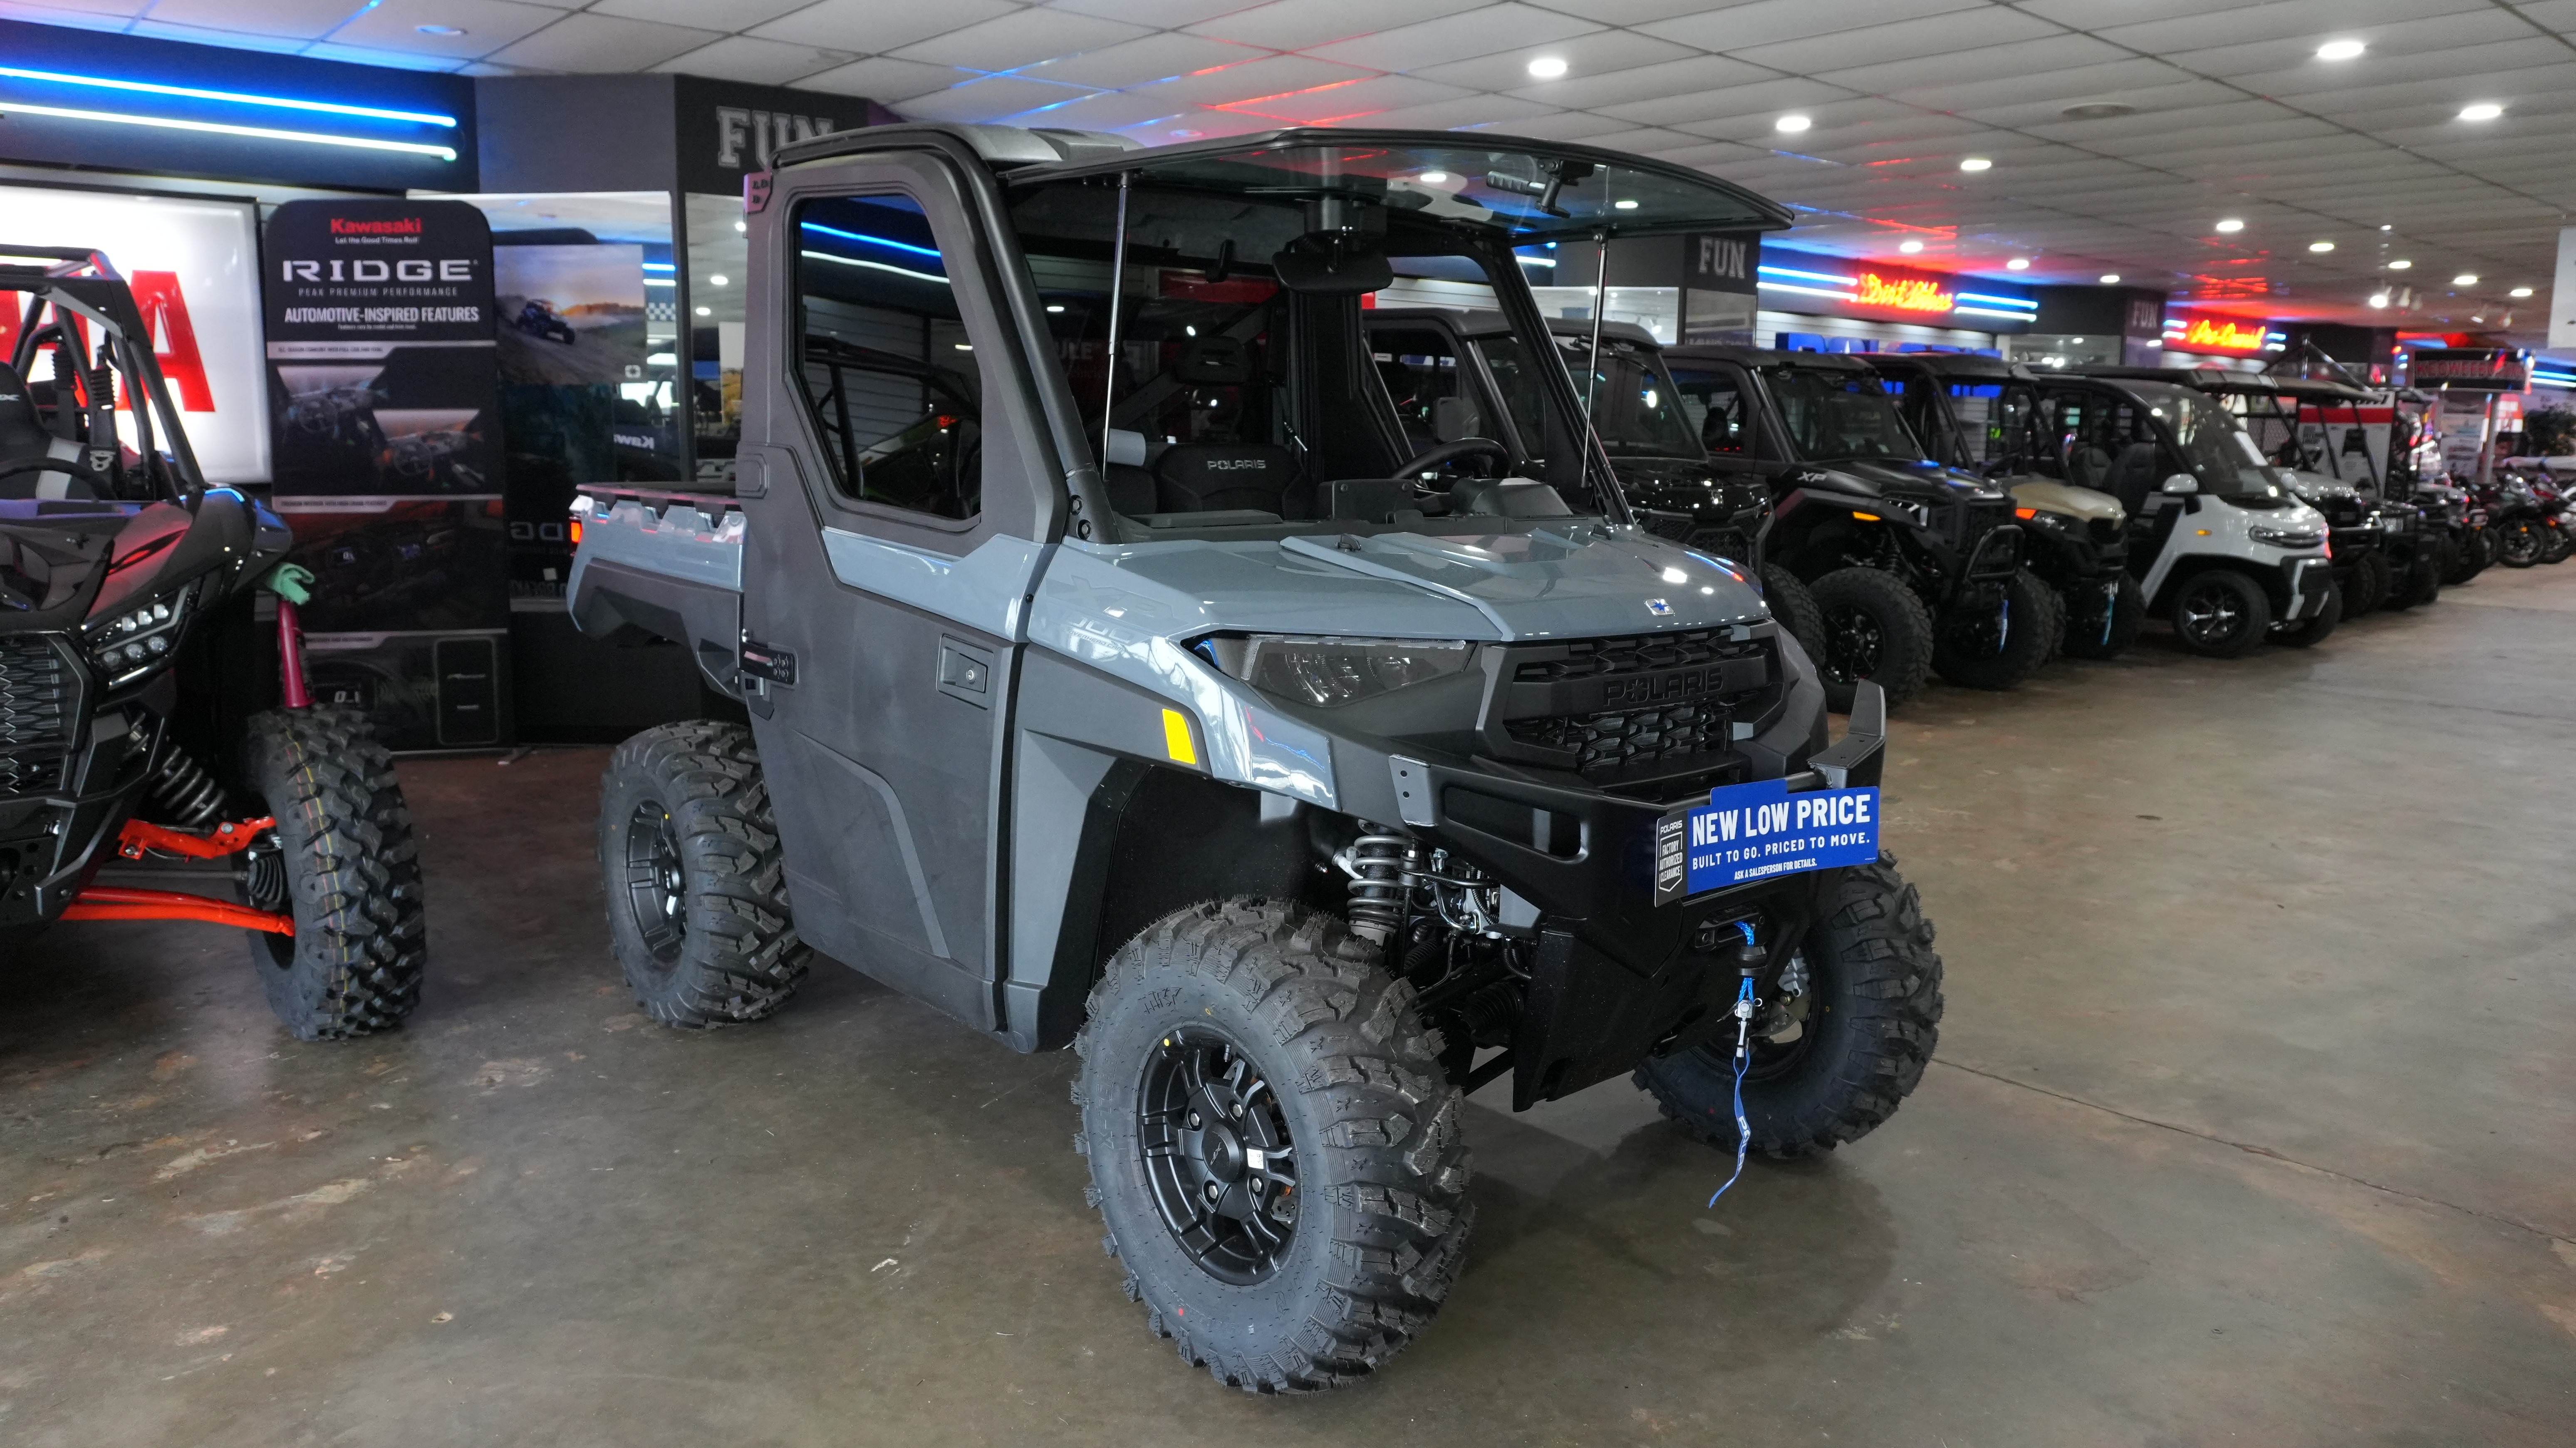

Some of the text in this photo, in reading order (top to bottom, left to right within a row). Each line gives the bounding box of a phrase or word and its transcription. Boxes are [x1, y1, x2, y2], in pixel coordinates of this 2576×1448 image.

[331, 218, 421, 233] Kawasaki
[1699, 236, 1746, 279] FUN
[299, 287, 457, 297] PEAK PREMIUM PERFORMANCE
[285, 307, 480, 323] AUTOMOTIVE-INSPIRED FEATURES
[2132, 300, 2159, 329] FUN
[1207, 460, 1266, 470] POLARIS
[1797, 471, 1827, 482] XP
[1069, 630, 1124, 652] OVERHEAD CAM
[1603, 667, 1723, 707] POLARIS
[1660, 820, 1682, 835] POLARIS
[1693, 794, 1870, 847] NEW LOW PRICE
[1662, 840, 1679, 856] FACTORY
[1693, 832, 1870, 870] BUILT TO GO. PRICED TO MOVE.
[1659, 852, 1682, 871] AUTHORIZED
[1734, 858, 1817, 880] ASK A SALESPERSON FOR DETAILS.
[1661, 867, 1680, 883] CLEARANCE
